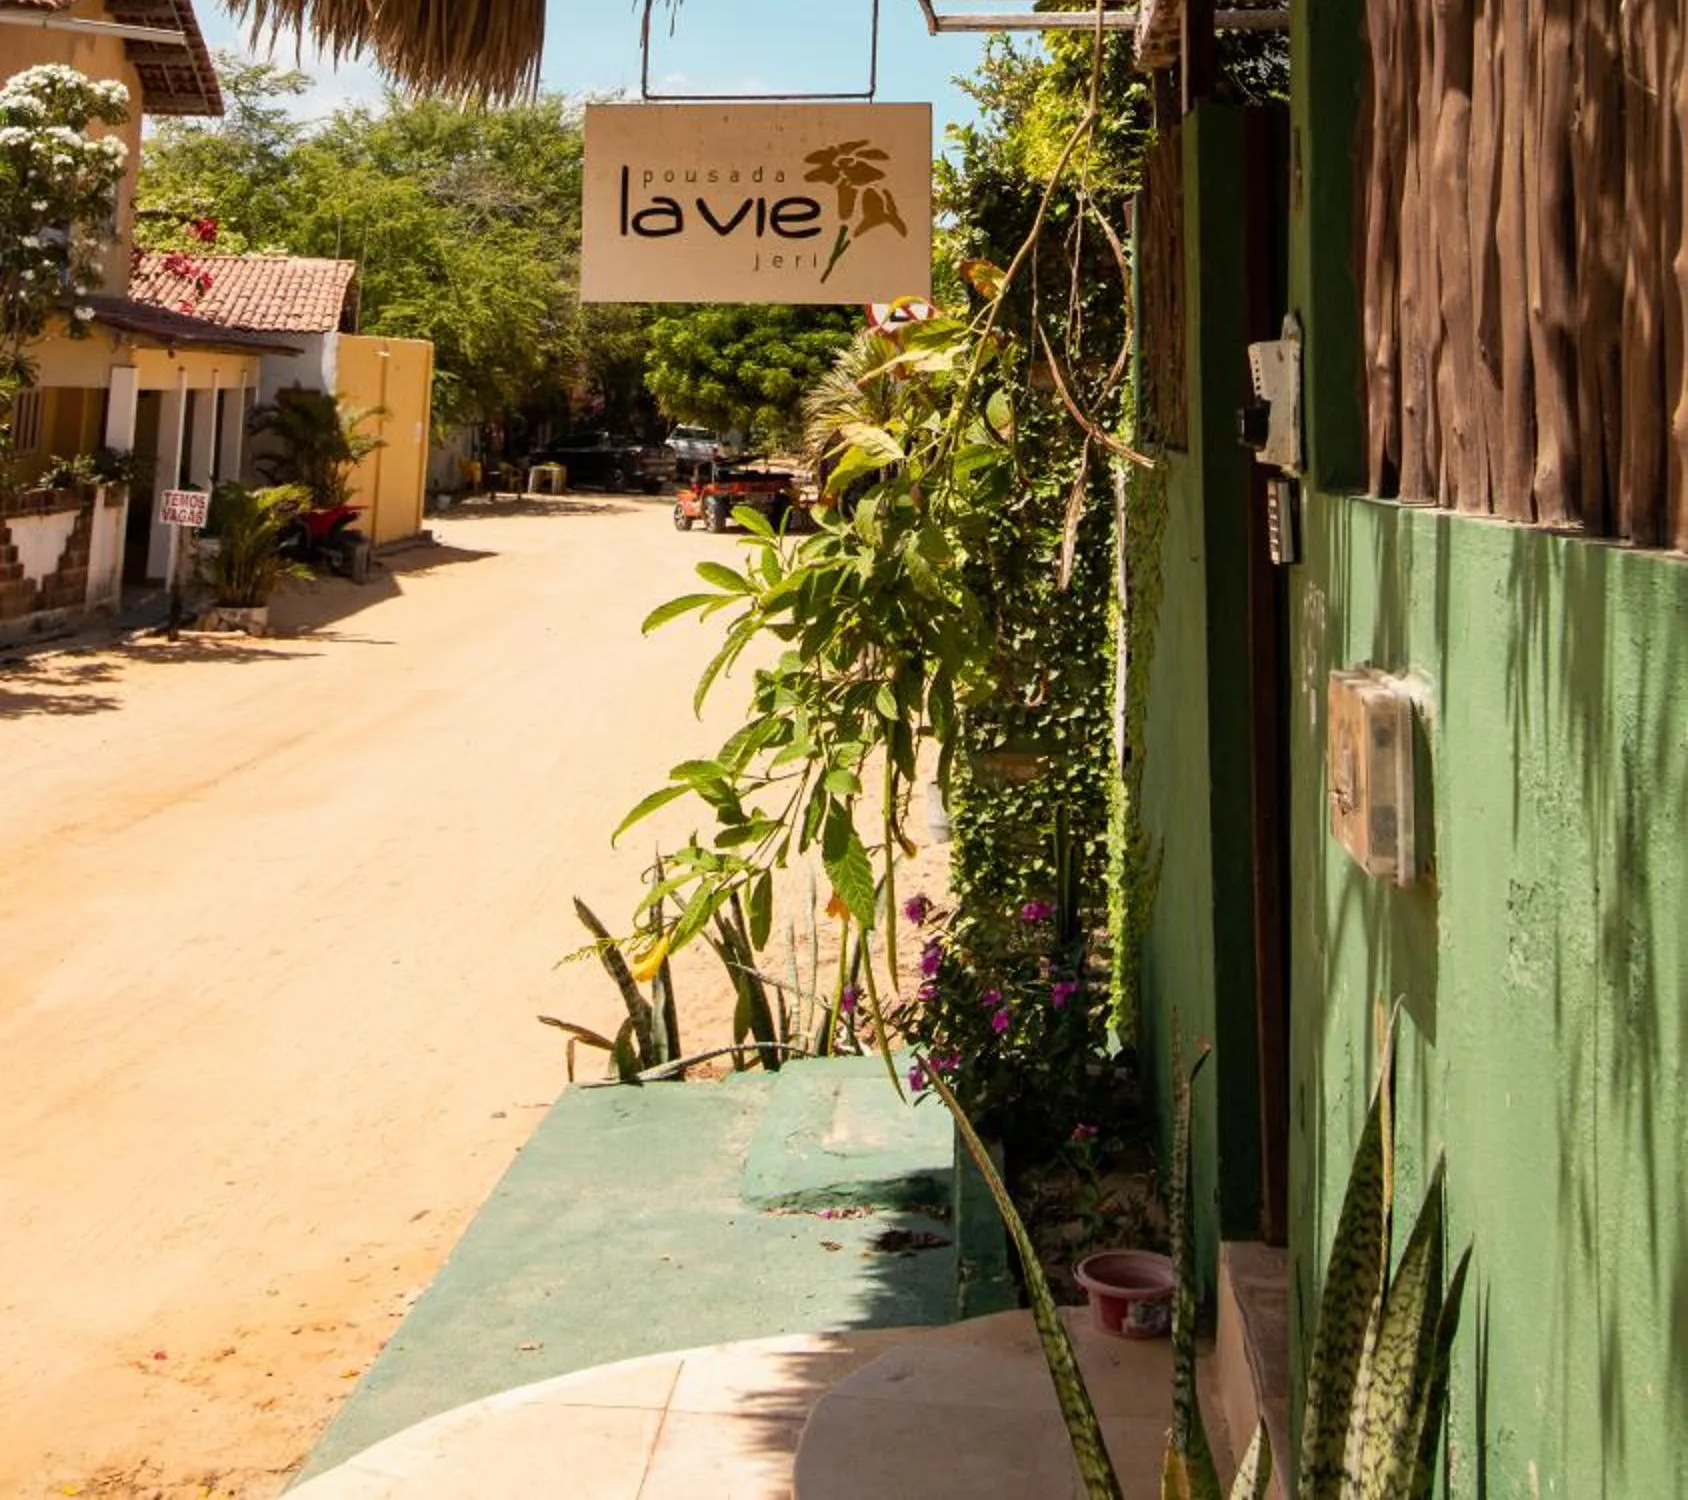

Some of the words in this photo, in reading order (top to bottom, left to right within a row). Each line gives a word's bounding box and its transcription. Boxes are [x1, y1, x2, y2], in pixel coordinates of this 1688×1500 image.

[643, 166, 786, 188] pousada
[752, 251, 818, 271] jeri
[165, 492, 205, 508] TEMOS
